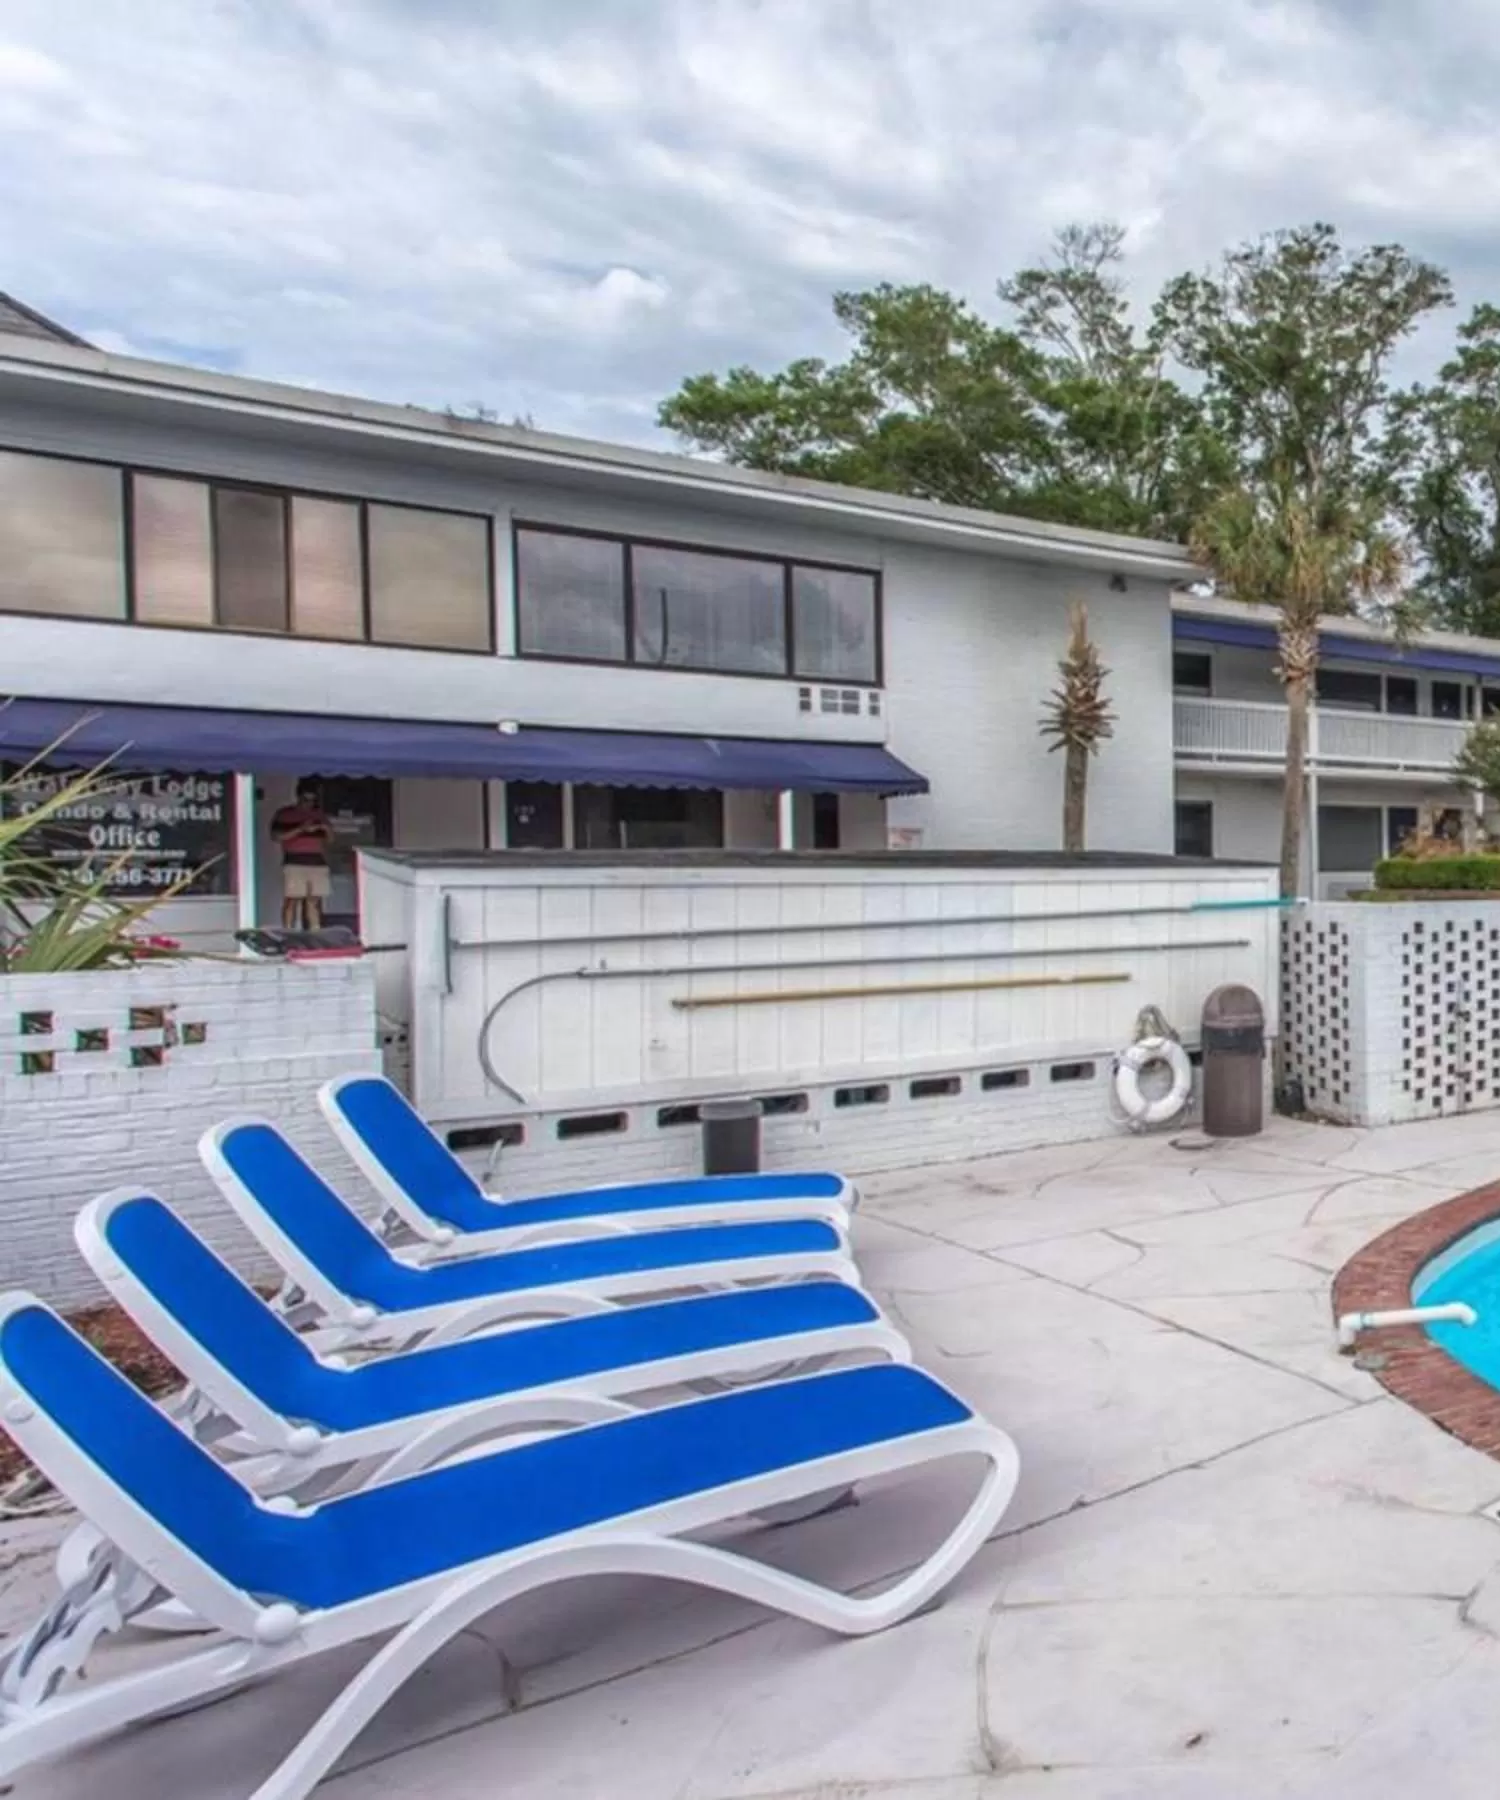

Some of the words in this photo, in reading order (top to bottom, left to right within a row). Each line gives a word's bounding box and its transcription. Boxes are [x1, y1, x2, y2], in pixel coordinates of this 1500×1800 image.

[152, 775, 223, 801] Lodge
[21, 802, 105, 820] Cndo
[112, 802, 132, 819] &
[140, 802, 221, 821] Rental
[89, 824, 160, 847] Office
